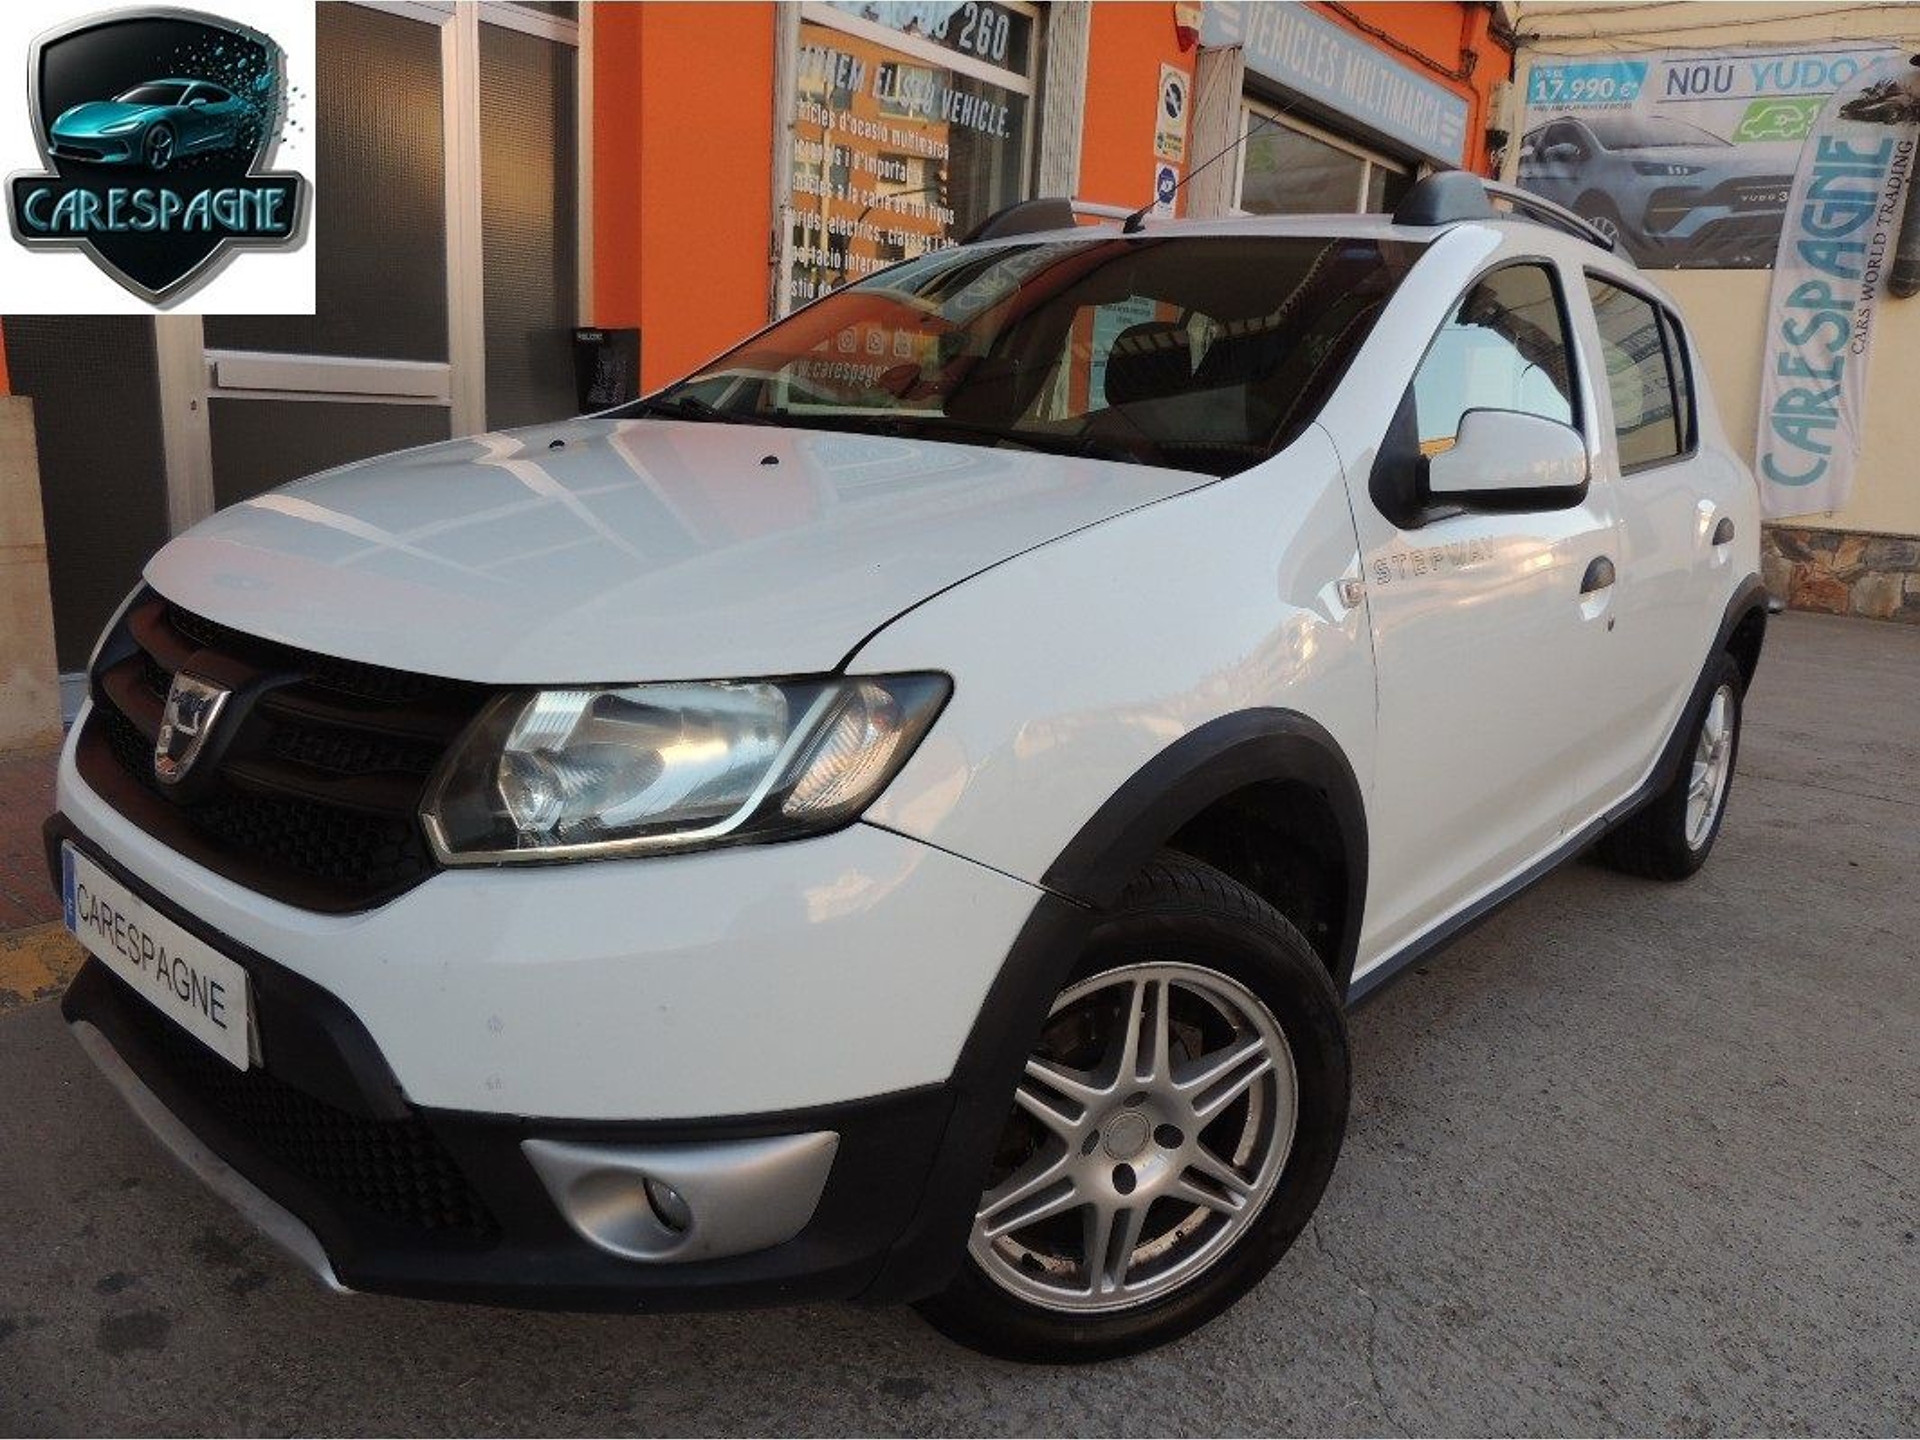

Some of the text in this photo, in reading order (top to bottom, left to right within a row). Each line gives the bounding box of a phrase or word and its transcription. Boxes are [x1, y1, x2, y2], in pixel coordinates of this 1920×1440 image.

[958, 2, 1010, 60] 260
[1246, 2, 1442, 144] VEHICLES MULTIMARCA
[1535, 78, 1616, 101] 17.990
[1666, 65, 1735, 96] NOU
[1751, 56, 1859, 92] YUDO
[942, 86, 1010, 139] VEHICLE.
[1850, 140, 1913, 356] CARS WORLD TRADING
[1760, 133, 1894, 488] CARESPAGNE
[1374, 536, 1494, 586] STEPWAY
[76, 883, 228, 1031] CARESPAGNE
